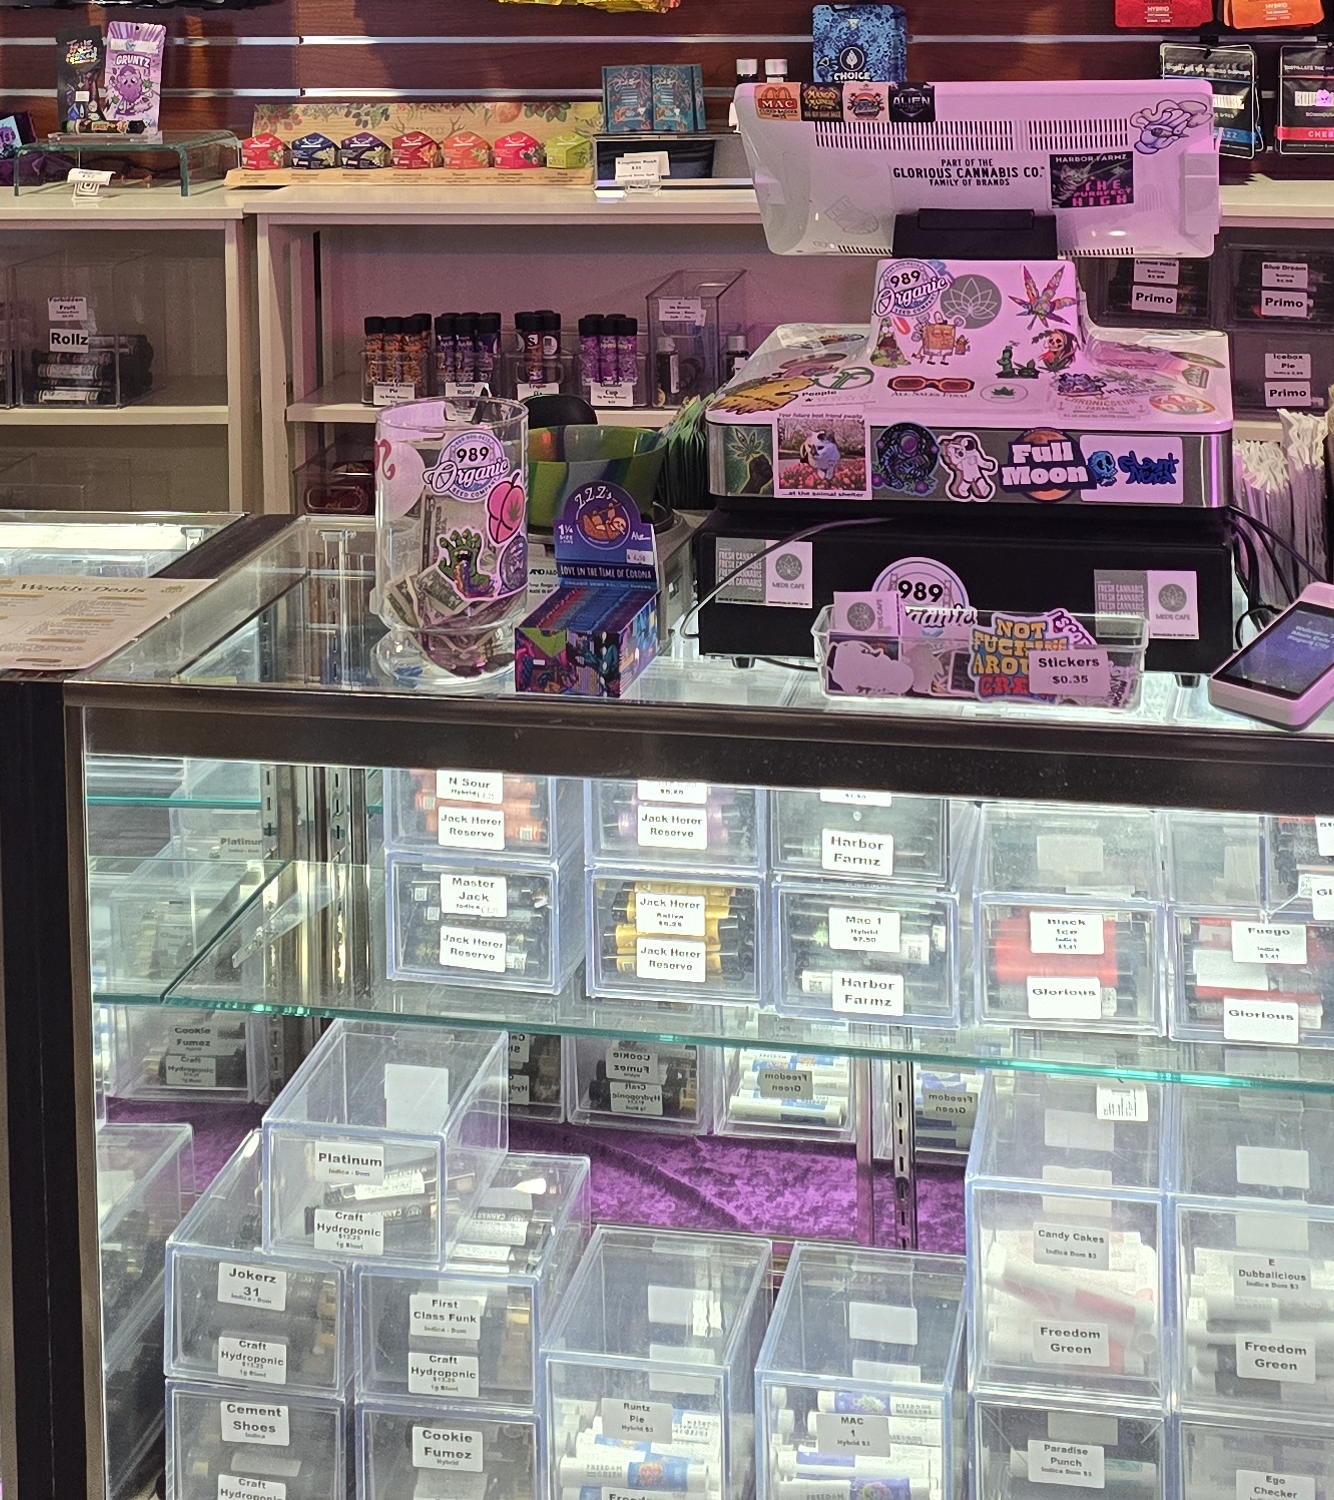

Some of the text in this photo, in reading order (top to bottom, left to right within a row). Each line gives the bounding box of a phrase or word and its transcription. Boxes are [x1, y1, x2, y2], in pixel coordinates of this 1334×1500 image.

[762, 100, 794, 108] MAC
[893, 96, 930, 107] ALIEN
[941, 159, 961, 167] PART
[1055, 155, 1092, 163] HARBOR
[893, 167, 1042, 178] GLORIOUS CANNABIS CO.
[890, 271, 920, 288] 989
[875, 278, 947, 316] Organic
[1135, 291, 1174, 305] Primo
[1266, 299, 1303, 308] Primo
[456, 447, 490, 462] 989
[1011, 442, 1073, 463] Full
[428, 455, 509, 494] Organic
[1002, 462, 1088, 485] Moon
[19, 582, 147, 595] Weekly Deals
[898, 580, 944, 602] 989
[997, 620, 1047, 637] NOT
[1038, 658, 1099, 668] Stickers
[1052, 675, 1088, 684] $0.35
[831, 837, 884, 849] Harbor
[834, 853, 881, 866] Farmz
[458, 891, 489, 902] Jack
[1032, 987, 1096, 997] Glorious
[1229, 1009, 1294, 1020] Glorious
[318, 1153, 382, 1167] Platinum
[335, 1212, 363, 1221] Craft
[317, 1223, 381, 1237] Hydroponic
[1038, 1228, 1105, 1243] Candy Cakes
[229, 1269, 277, 1284] Jokerz
[1238, 1270, 1307, 1281] Dubbalicious
[244, 1286, 259, 1297] 31
[432, 1300, 458, 1309] First
[413, 1311, 477, 1323] Class Funk
[1040, 1327, 1100, 1339] Freedom
[239, 1340, 266, 1350] Craft
[1051, 1342, 1092, 1354] Green
[1245, 1342, 1307, 1355] Freedom
[221, 1351, 284, 1366] Hydroponic
[429, 1355, 457, 1364] Craft
[1255, 1357, 1298, 1370] Green
[411, 1367, 476, 1379] Hydroponic
[227, 1404, 281, 1417] Cement
[623, 1403, 651, 1412] Runtz
[629, 1414, 645, 1423] Pie
[841, 1416, 864, 1425] MAC
[233, 1421, 276, 1433] Shoes
[422, 1431, 473, 1443] Cookie
[425, 1447, 472, 1460] Fumez
[1044, 1444, 1088, 1456] Paradise
[1051, 1456, 1082, 1468] Punch
[1266, 1476, 1285, 1486] Ego
